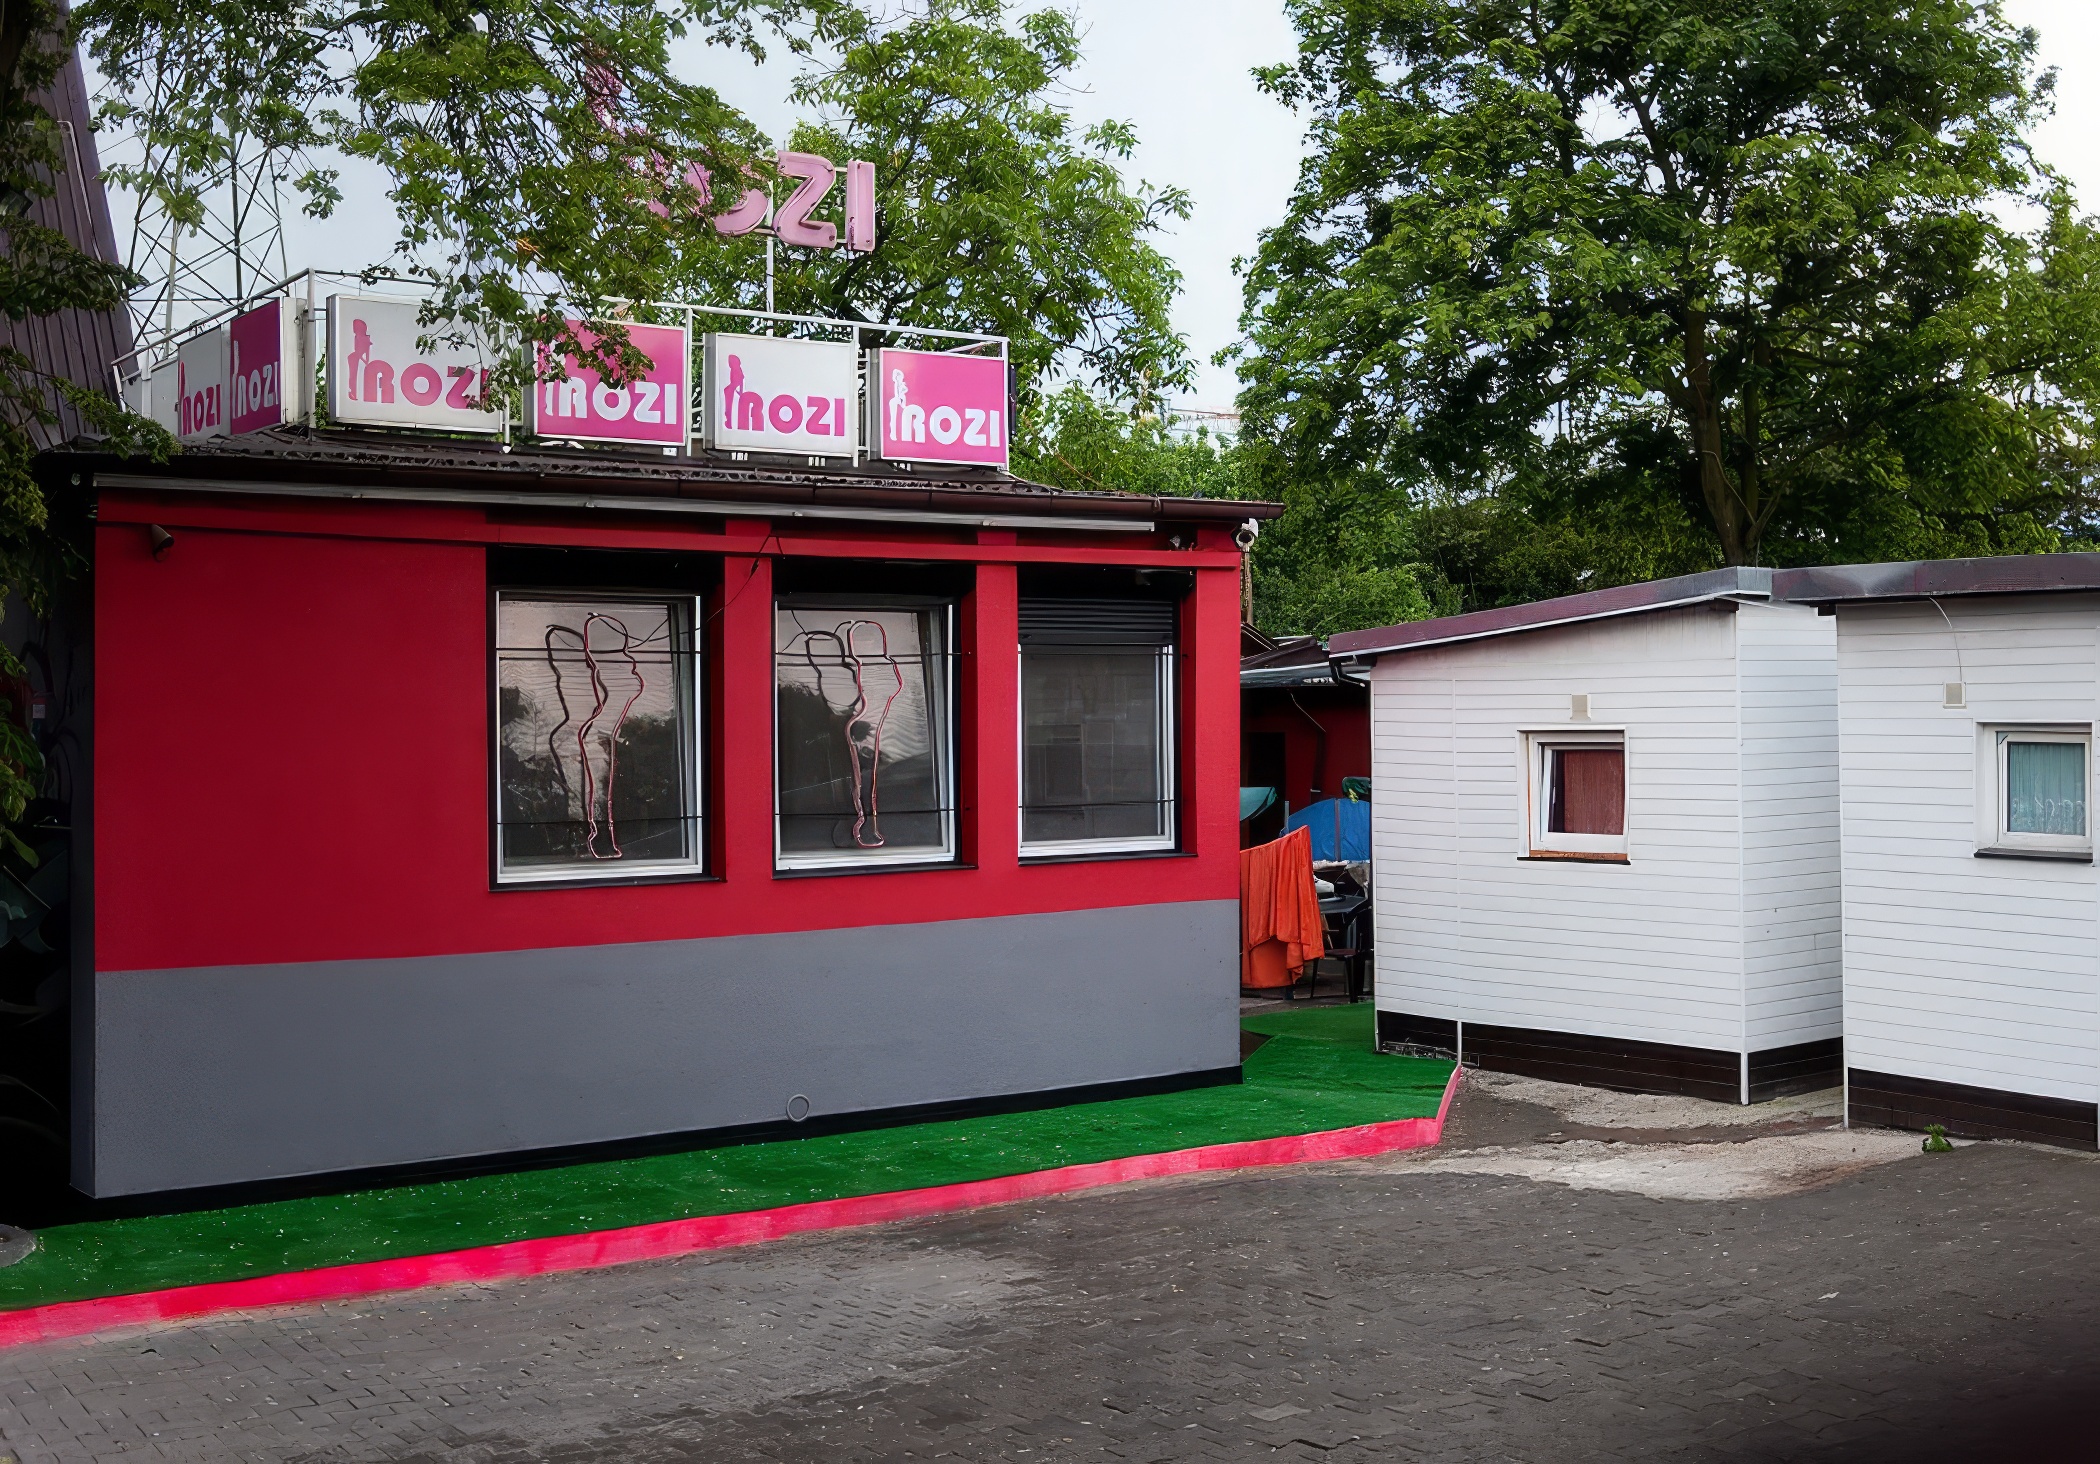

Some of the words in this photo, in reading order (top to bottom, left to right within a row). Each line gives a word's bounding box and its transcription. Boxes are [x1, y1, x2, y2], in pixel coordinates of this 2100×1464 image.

[558, 377, 677, 425] ROZI
[738, 391, 845, 436] ROZI
[901, 404, 1000, 447] ROZI
